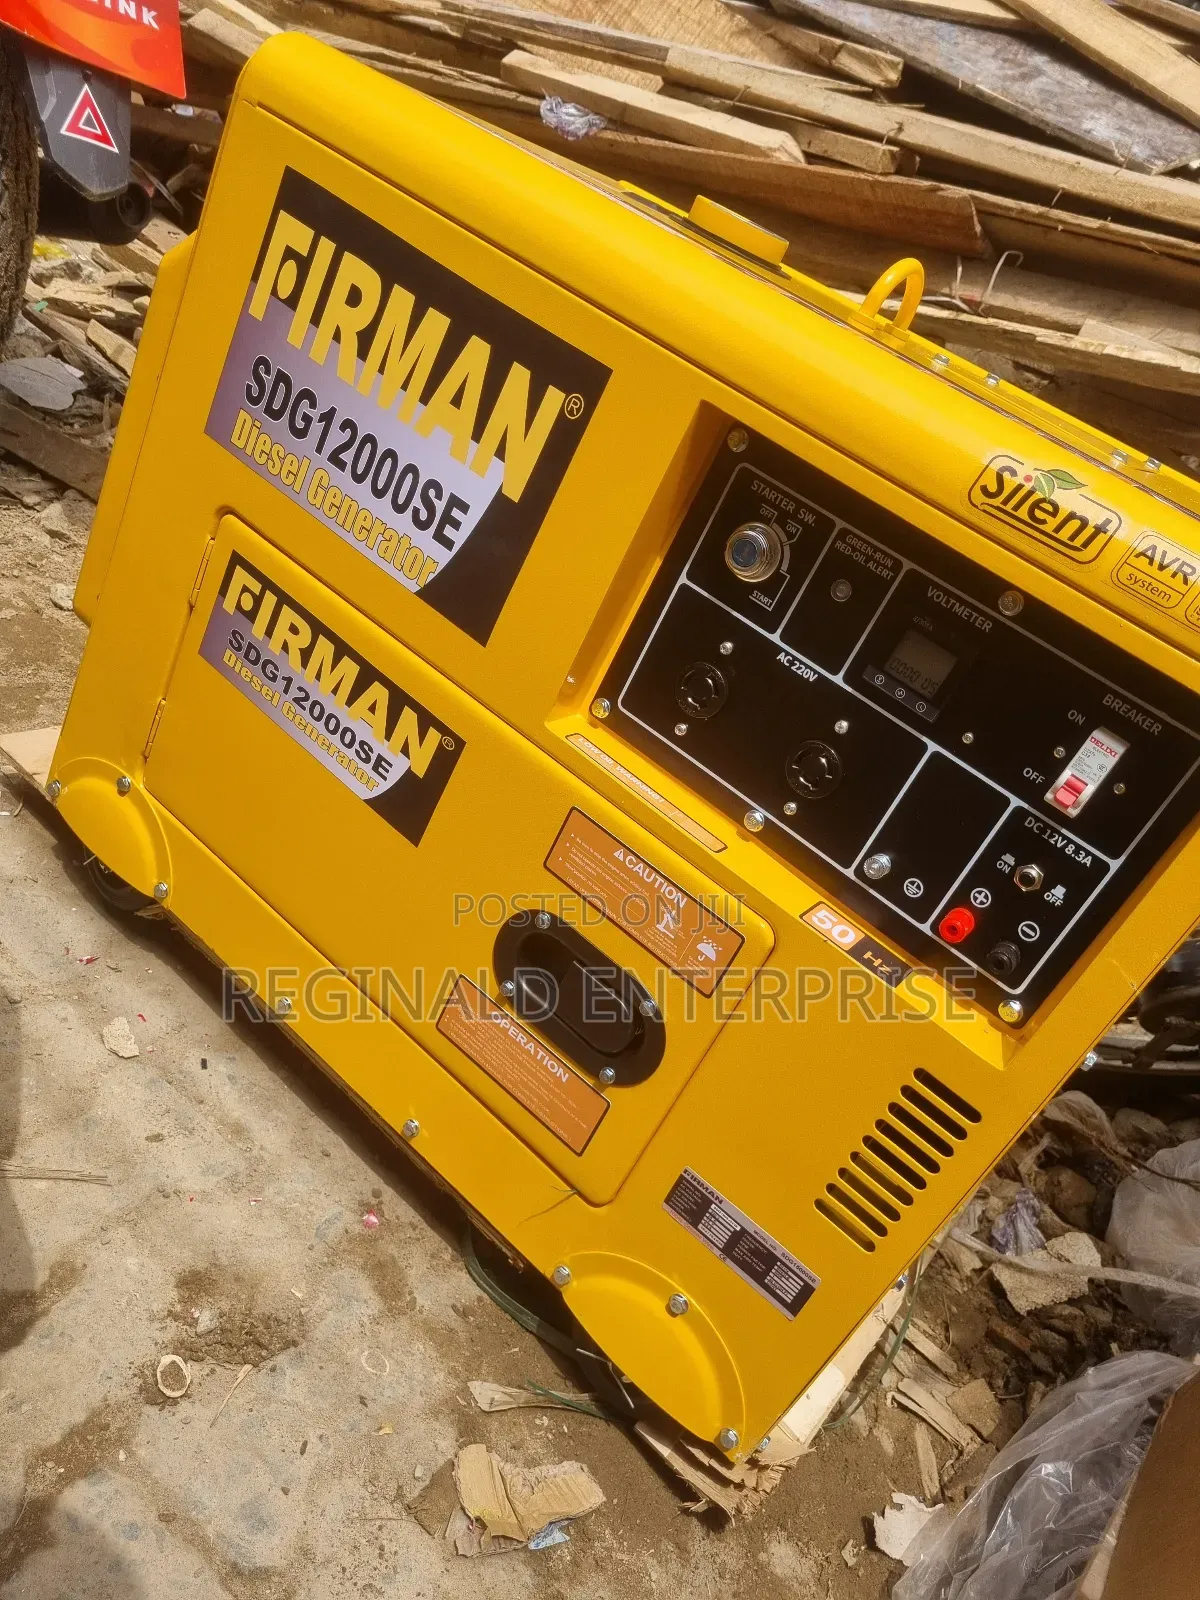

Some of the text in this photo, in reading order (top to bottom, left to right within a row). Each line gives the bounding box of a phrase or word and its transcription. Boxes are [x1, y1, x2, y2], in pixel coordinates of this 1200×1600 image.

[244, 354, 471, 553] SDG12000SE
[230, 408, 439, 588] Diesel Generator
[750, 480, 816, 527] STARTER SW.
[759, 507, 774, 519] OFF
[980, 465, 1114, 551] Silent
[785, 523, 798, 535] ON
[835, 540, 895, 580] RED-OIL ALERT
[845, 534, 894, 568] GREEN-RUN
[1132, 544, 1197, 586] AVR
[752, 590, 773, 607] START
[1126, 571, 1172, 603] system
[927, 585, 993, 633] VOLTMETER
[776, 651, 819, 682] AC 220V
[222, 648, 380, 792] Diesel Generator
[228, 628, 393, 781] SDG12000SE
[1067, 709, 1086, 726] ON
[1102, 693, 1163, 736] BREAKER
[577, 737, 602, 754] LOW
[1089, 736, 1118, 758] DELIXI
[1022, 767, 1046, 785] OFF
[1024, 816, 1093, 868] DC 12V 8.3A
[625, 855, 688, 908] CAUTION
[996, 860, 1012, 874] ON
[1043, 891, 1064, 907] OFF
[811, 909, 893, 976] 50 Hz
[490, 1011, 569, 1083] OPERATION
[682, 1167, 724, 1205] FIRMAN
